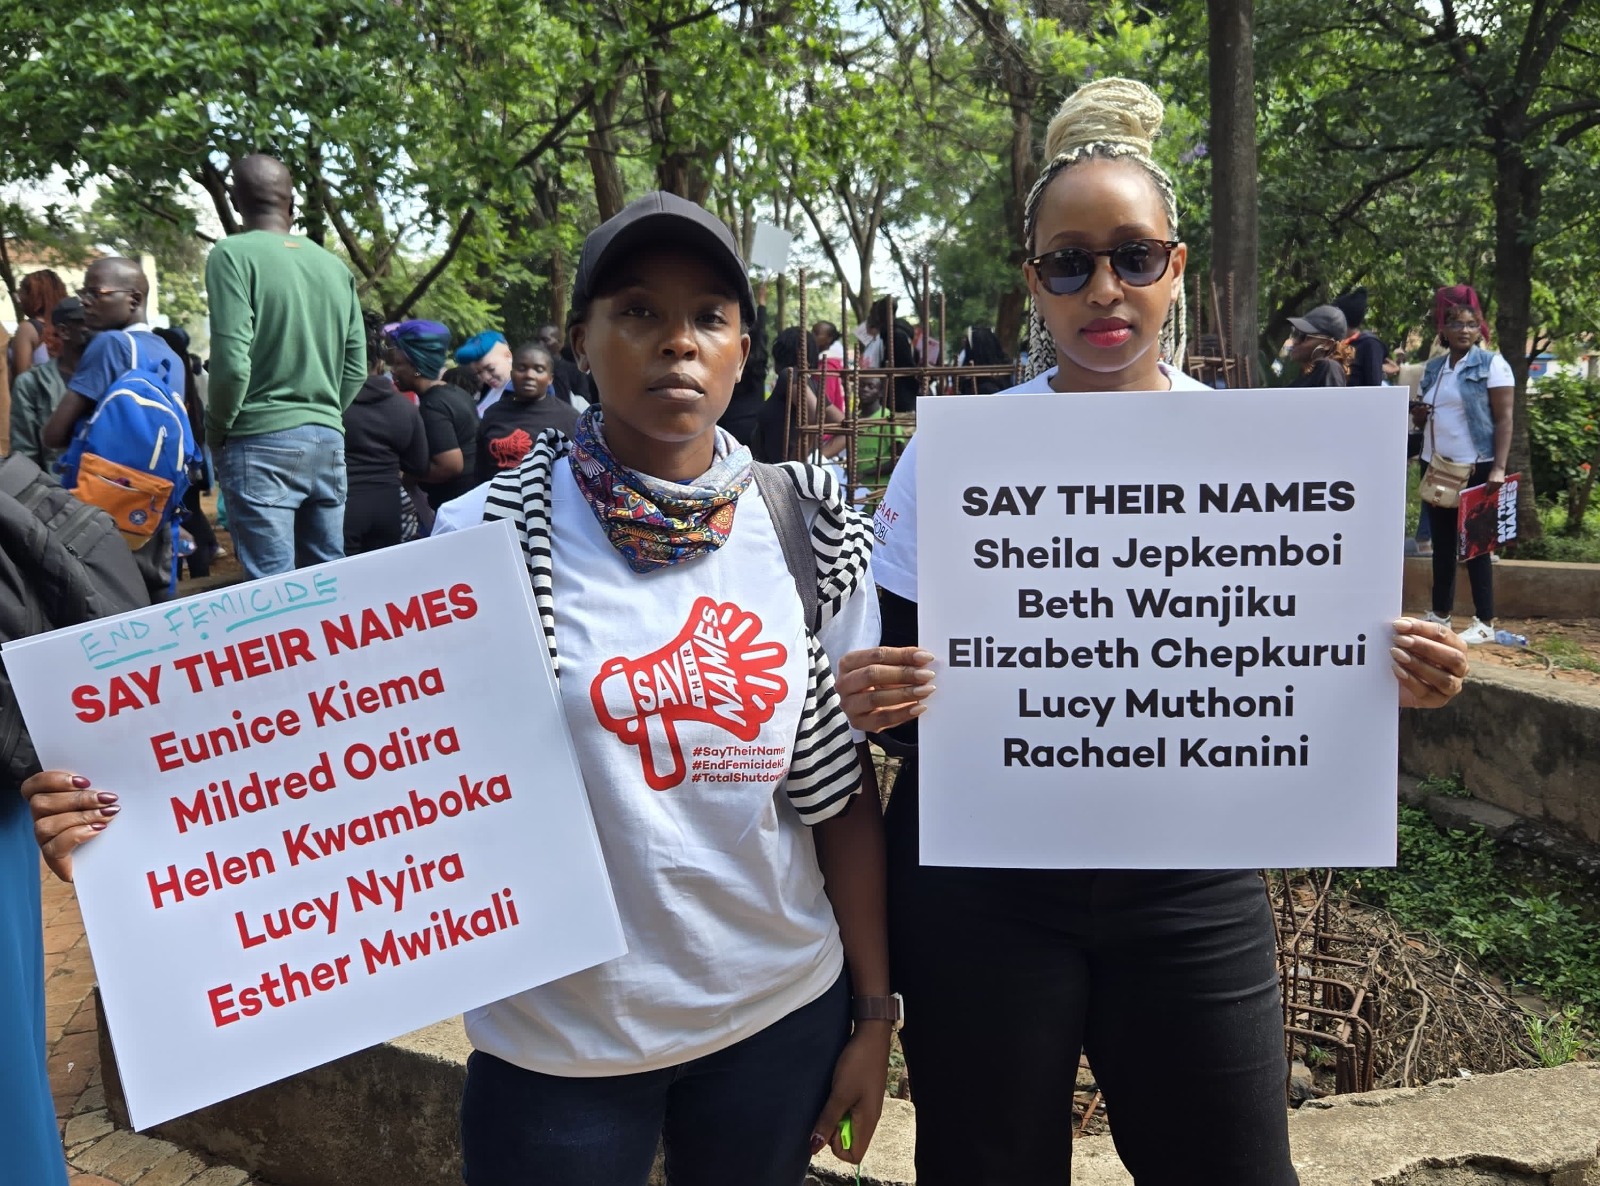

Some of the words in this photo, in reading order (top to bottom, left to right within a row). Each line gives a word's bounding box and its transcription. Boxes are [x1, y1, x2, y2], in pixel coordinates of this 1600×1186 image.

[962, 485, 1046, 516] SAY
[1057, 483, 1186, 515] THEIR
[1198, 480, 1356, 513] NAMES
[1506, 480, 1518, 540] NAMES
[973, 536, 1099, 569] Sheila
[1112, 532, 1342, 577] Jepkemboi
[1497, 520, 1507, 543] SAY
[79, 620, 151, 661] END
[164, 572, 338, 636] FEMICIDE
[1017, 587, 1114, 618] Beth
[1126, 584, 1296, 627] Wanjiku
[71, 664, 162, 724] SAY
[173, 627, 316, 694] THEIR
[321, 582, 479, 656] NAMES
[632, 652, 690, 712] SAY
[683, 647, 704, 703] THEIR
[693, 605, 747, 726] NAMES
[948, 636, 1139, 668] Elizabeth
[1151, 633, 1366, 677] Chepkurui
[149, 702, 301, 773] Eunice
[307, 665, 445, 729] Kiema
[1018, 687, 1116, 727] Lucy
[1126, 685, 1294, 718] Muthoni
[169, 752, 335, 834] Mildred
[343, 725, 461, 781] Odira
[1003, 737, 1166, 767] Rachael
[1180, 734, 1309, 767] Kanini
[146, 845, 276, 910] Helen
[282, 772, 513, 867] Kwamboka
[234, 890, 340, 950] Lucy
[346, 853, 466, 913] Nyira
[206, 953, 352, 1028] Esther
[360, 888, 520, 977] Mwikali
